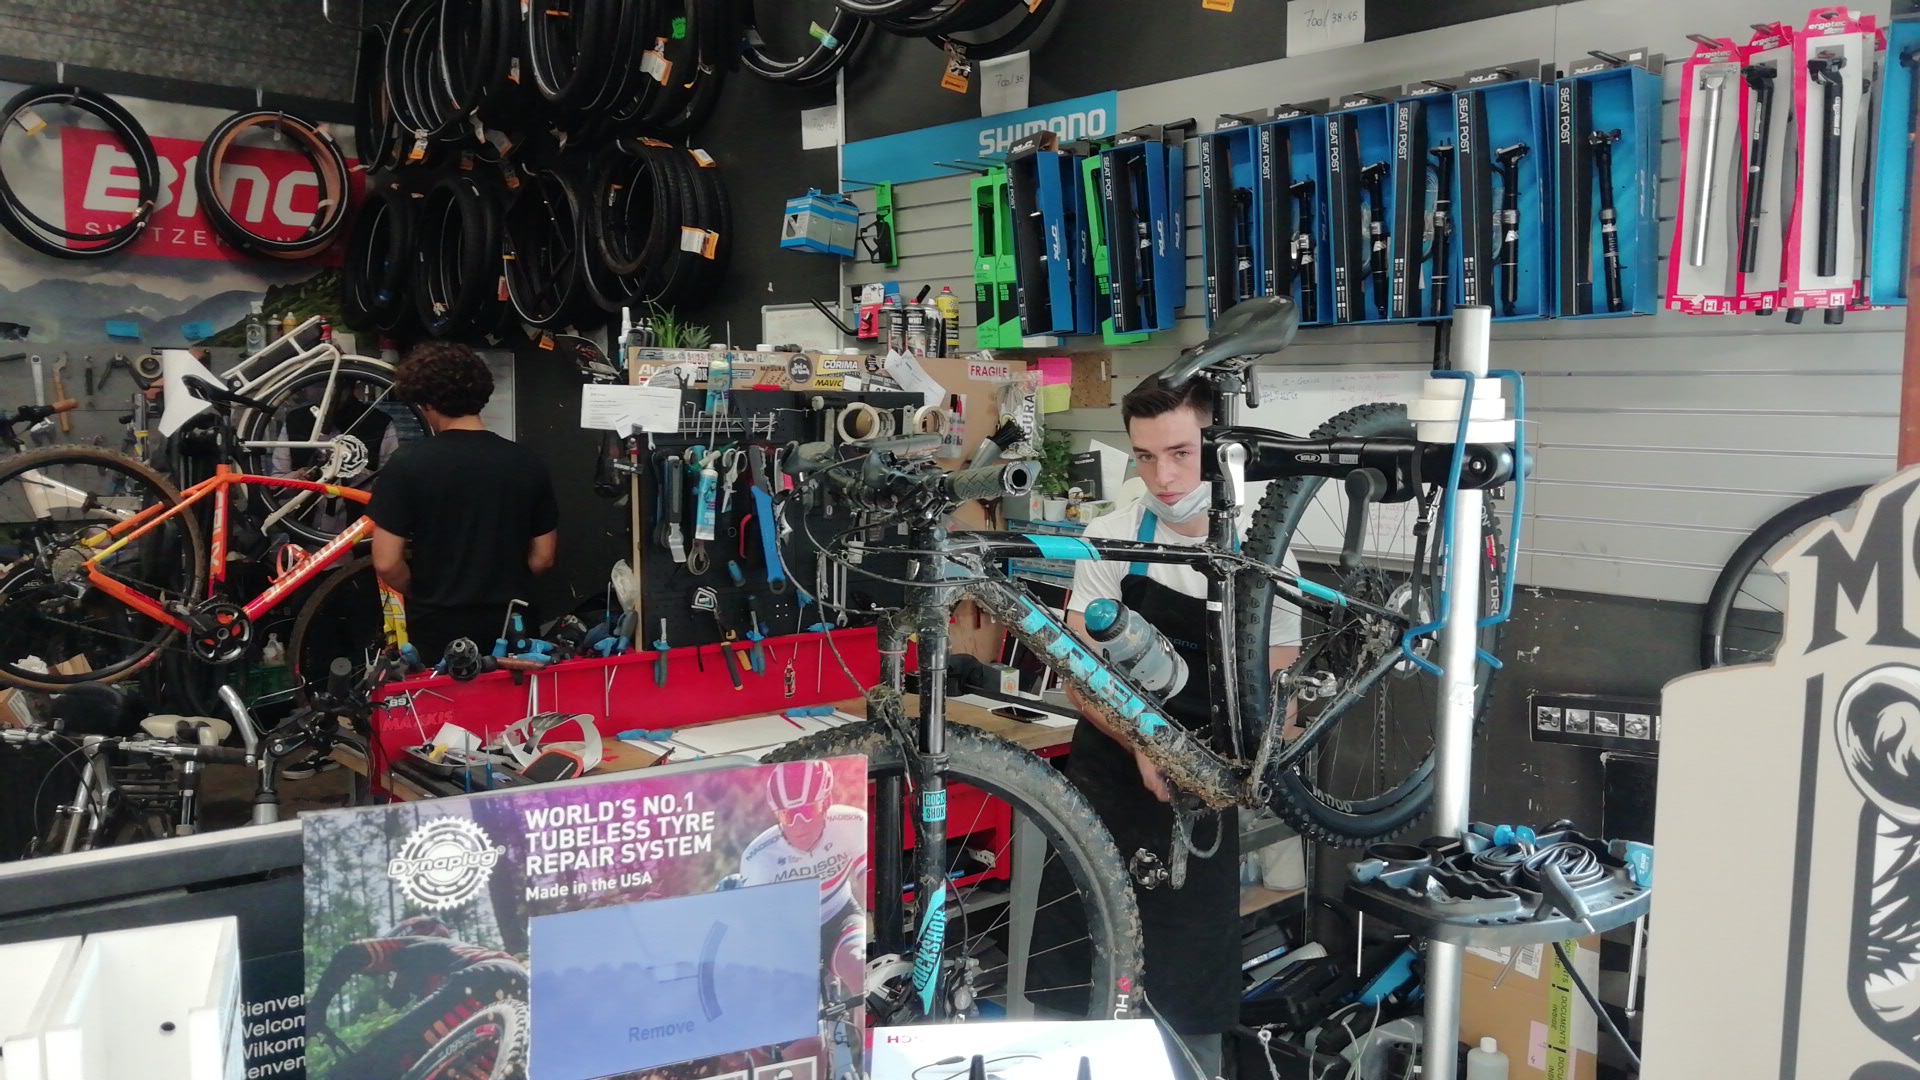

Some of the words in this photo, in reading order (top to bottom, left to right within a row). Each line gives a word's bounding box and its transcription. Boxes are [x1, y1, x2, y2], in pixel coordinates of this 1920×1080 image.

[1458, 98, 1468, 125] SEAT
[1560, 87, 1570, 116] SEAT
[979, 108, 1106, 156] SHIMANO
[1399, 107, 1409, 131] SEAT
[1560, 119, 1571, 145] POST
[1261, 131, 1270, 152] SEAT
[1330, 122, 1339, 145] SEAT
[1459, 128, 1470, 154] POST
[1201, 141, 1210, 162] SEAT
[1330, 147, 1340, 173] POST
[1398, 134, 1408, 160] POST
[1103, 156, 1111, 177] SEAT
[1203, 164, 1211, 189] POST
[1262, 155, 1270, 180] POST
[1105, 179, 1113, 201] POST
[638, 363, 668, 374] Avi
[823, 360, 859, 370] CORIMA
[970, 364, 1008, 377] FRAGILE
[1019, 594, 1169, 736] TREK
[642, 791, 694, 816] NO.1
[525, 819, 651, 853] TUBELESS
[656, 810, 716, 836] TYRE
[390, 849, 497, 877] Dynaplug
[526, 846, 615, 877] REPAIR
[620, 832, 712, 863] SYSTEM
[774, 851, 850, 882] MADISON
[526, 884, 569, 901] Made
[573, 881, 588, 895] in
[592, 877, 616, 892] the
[620, 871, 653, 888] USA
[628, 1020, 695, 1043] Remove
[1558, 995, 1568, 1045] DOCUMENTS
